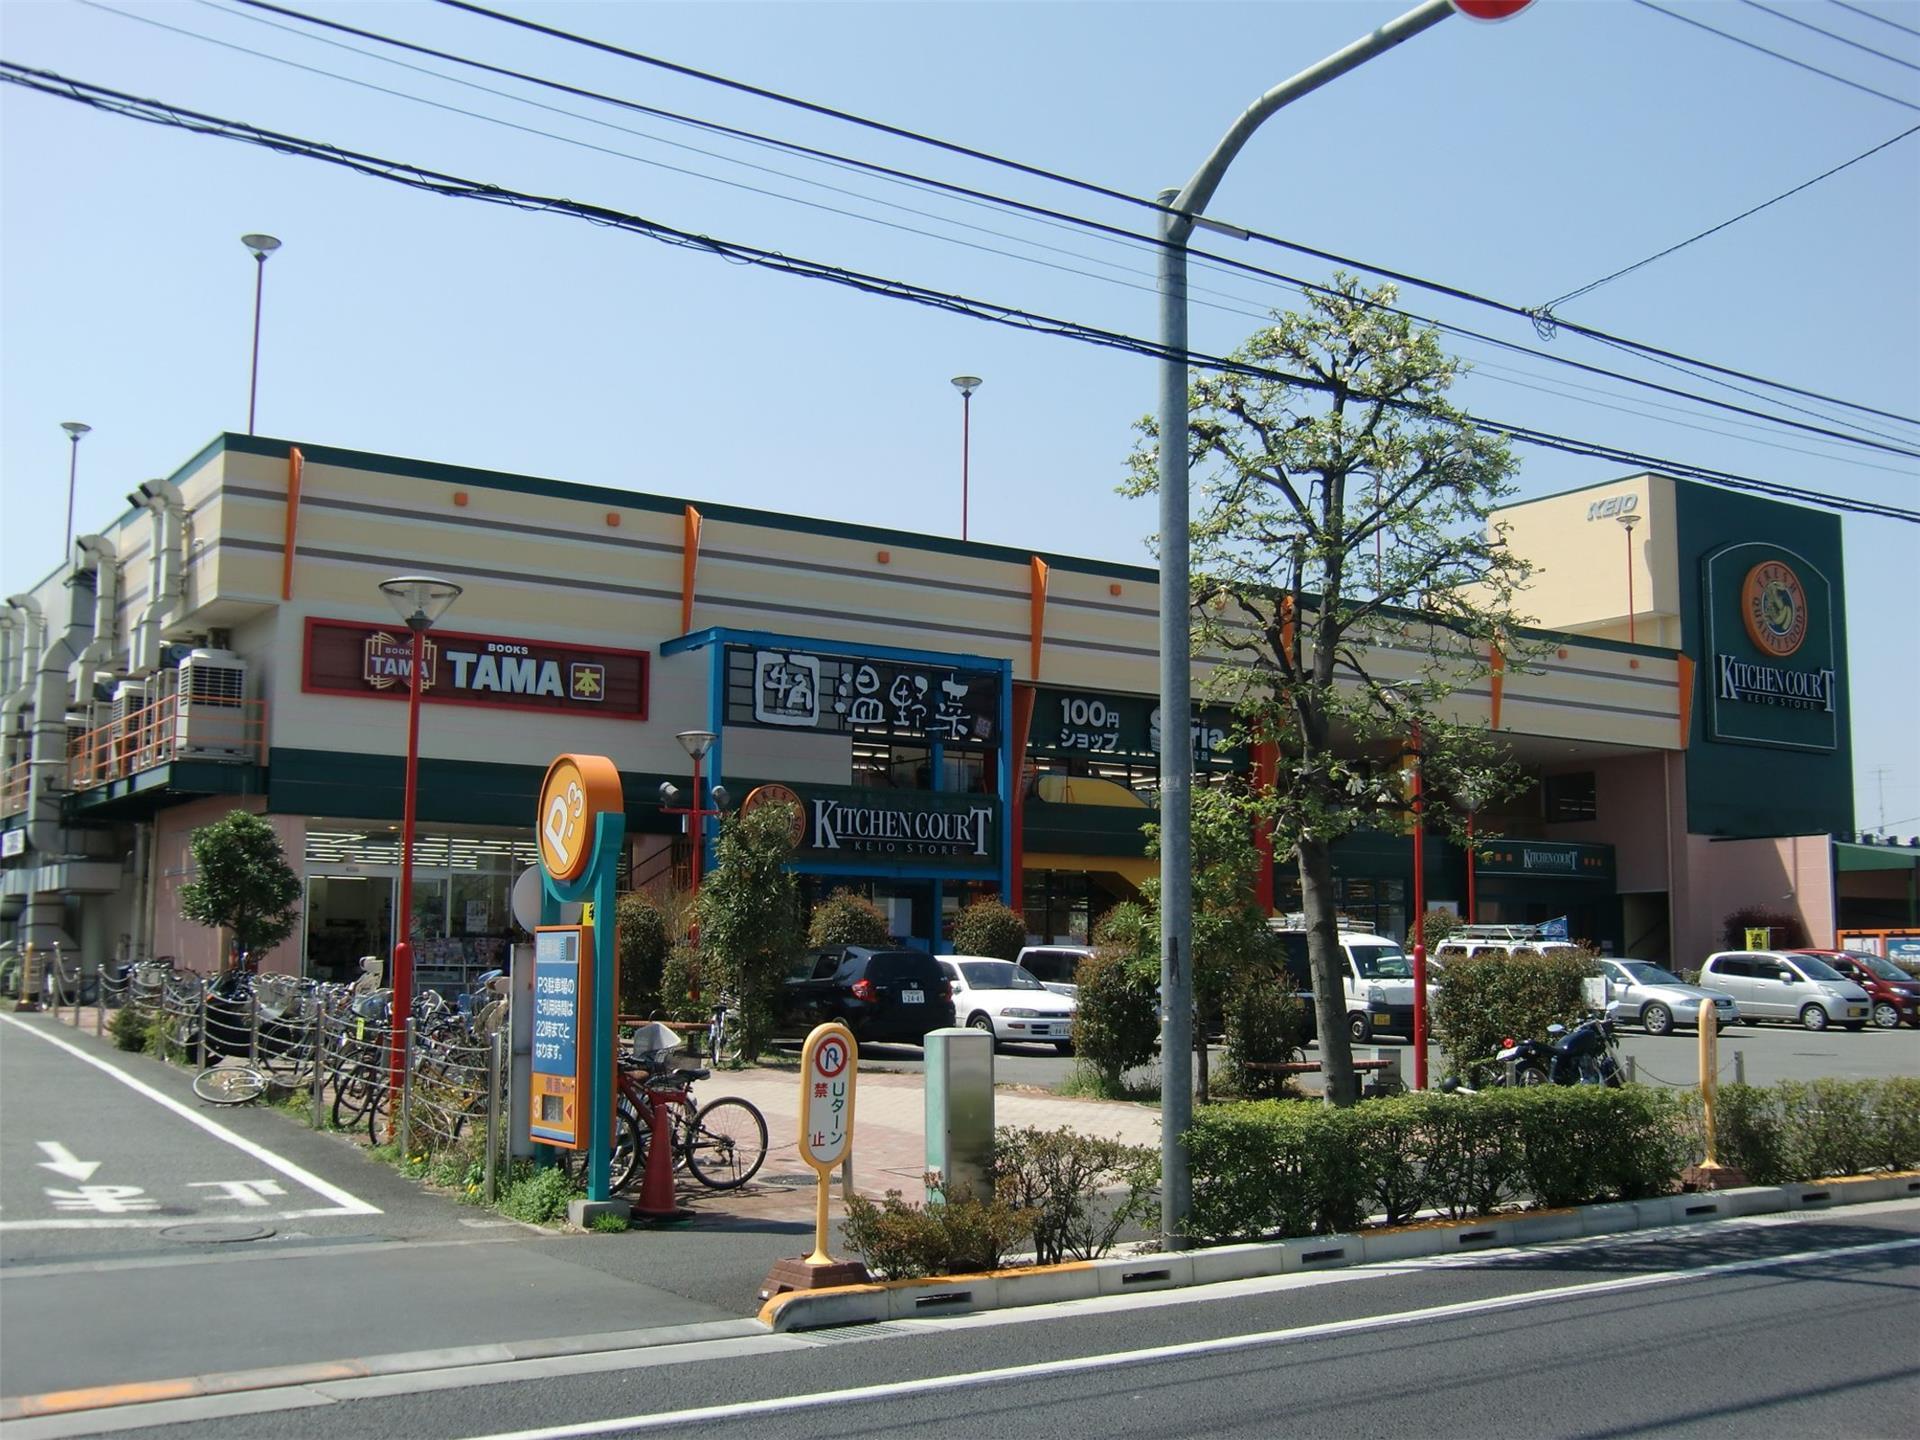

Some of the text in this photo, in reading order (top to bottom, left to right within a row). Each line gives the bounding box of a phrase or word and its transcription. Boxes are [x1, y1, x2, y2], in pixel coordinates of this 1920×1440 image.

[1586, 493, 1638, 521] KEIO
[488, 642, 529, 655] BOOKS
[446, 650, 564, 697] TAMA
[1719, 654, 1836, 713] KITCHEN COURT
[834, 664, 971, 737] 温野菜
[1060, 697, 1120, 729] 100円
[1747, 695, 1816, 711] KEIO STORE
[1060, 728, 1120, 750] ショップ
[812, 799, 916, 849] KITCHEN
[915, 806, 992, 856] COURT
[855, 841, 958, 855] KEIO STORE
[537, 976, 575, 994] P3駐車場の
[535, 1020, 570, 1039] 22時までと
[812, 1082, 828, 1147] 禁止
[830, 1081, 845, 1146] Uターン
